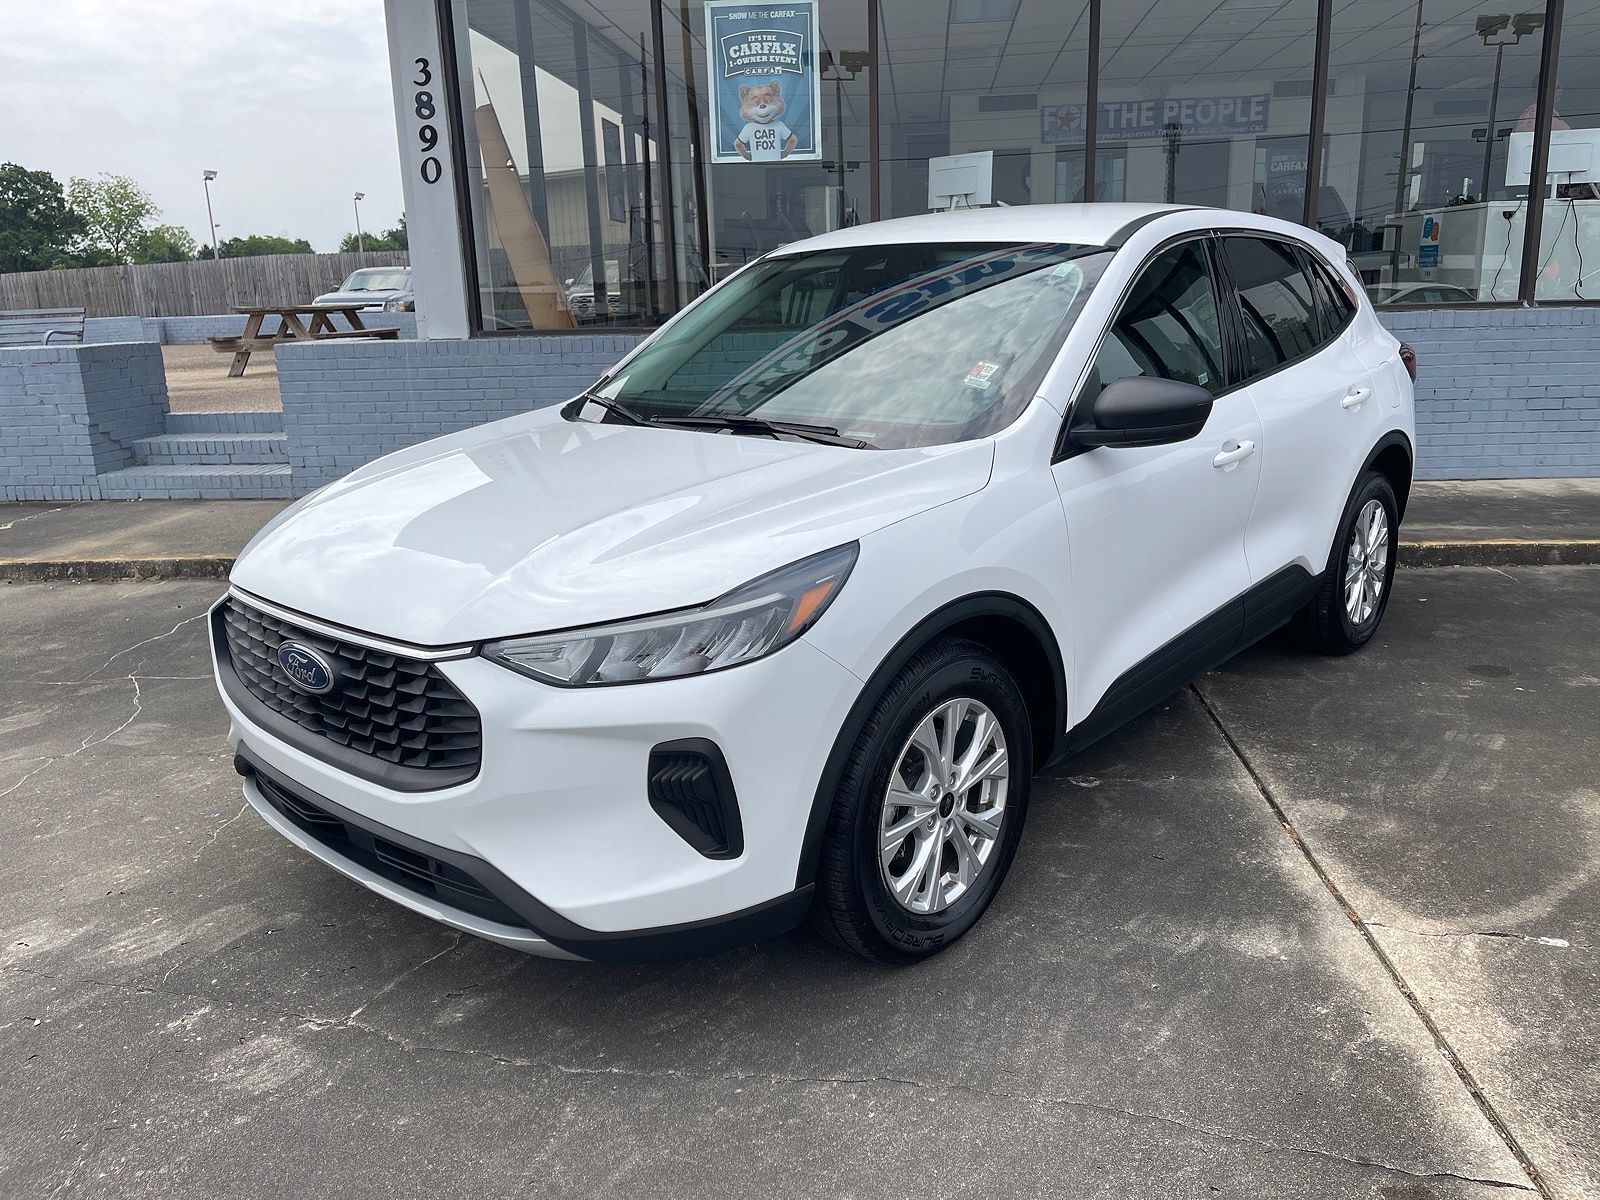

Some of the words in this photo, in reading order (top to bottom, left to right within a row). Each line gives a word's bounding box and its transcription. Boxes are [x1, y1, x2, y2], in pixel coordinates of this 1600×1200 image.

[728, 12, 747, 20] SHOW
[758, 11, 769, 19] THE
[770, 10, 795, 18] CARFAX
[748, 34, 761, 42] IT'S
[729, 42, 797, 58] CARFAX
[729, 55, 768, 67] 1-OWNER
[769, 56, 797, 65] EVENT
[744, 66, 782, 76] CARFAX
[1043, 107, 1087, 132] FO
[1104, 102, 1154, 128] THE
[1163, 97, 1265, 124] PEOPLE
[413, 57, 442, 184] 3890
[754, 129, 775, 140] CAR
[756, 140, 775, 150] FOX
[287, 653, 316, 683] Ford
